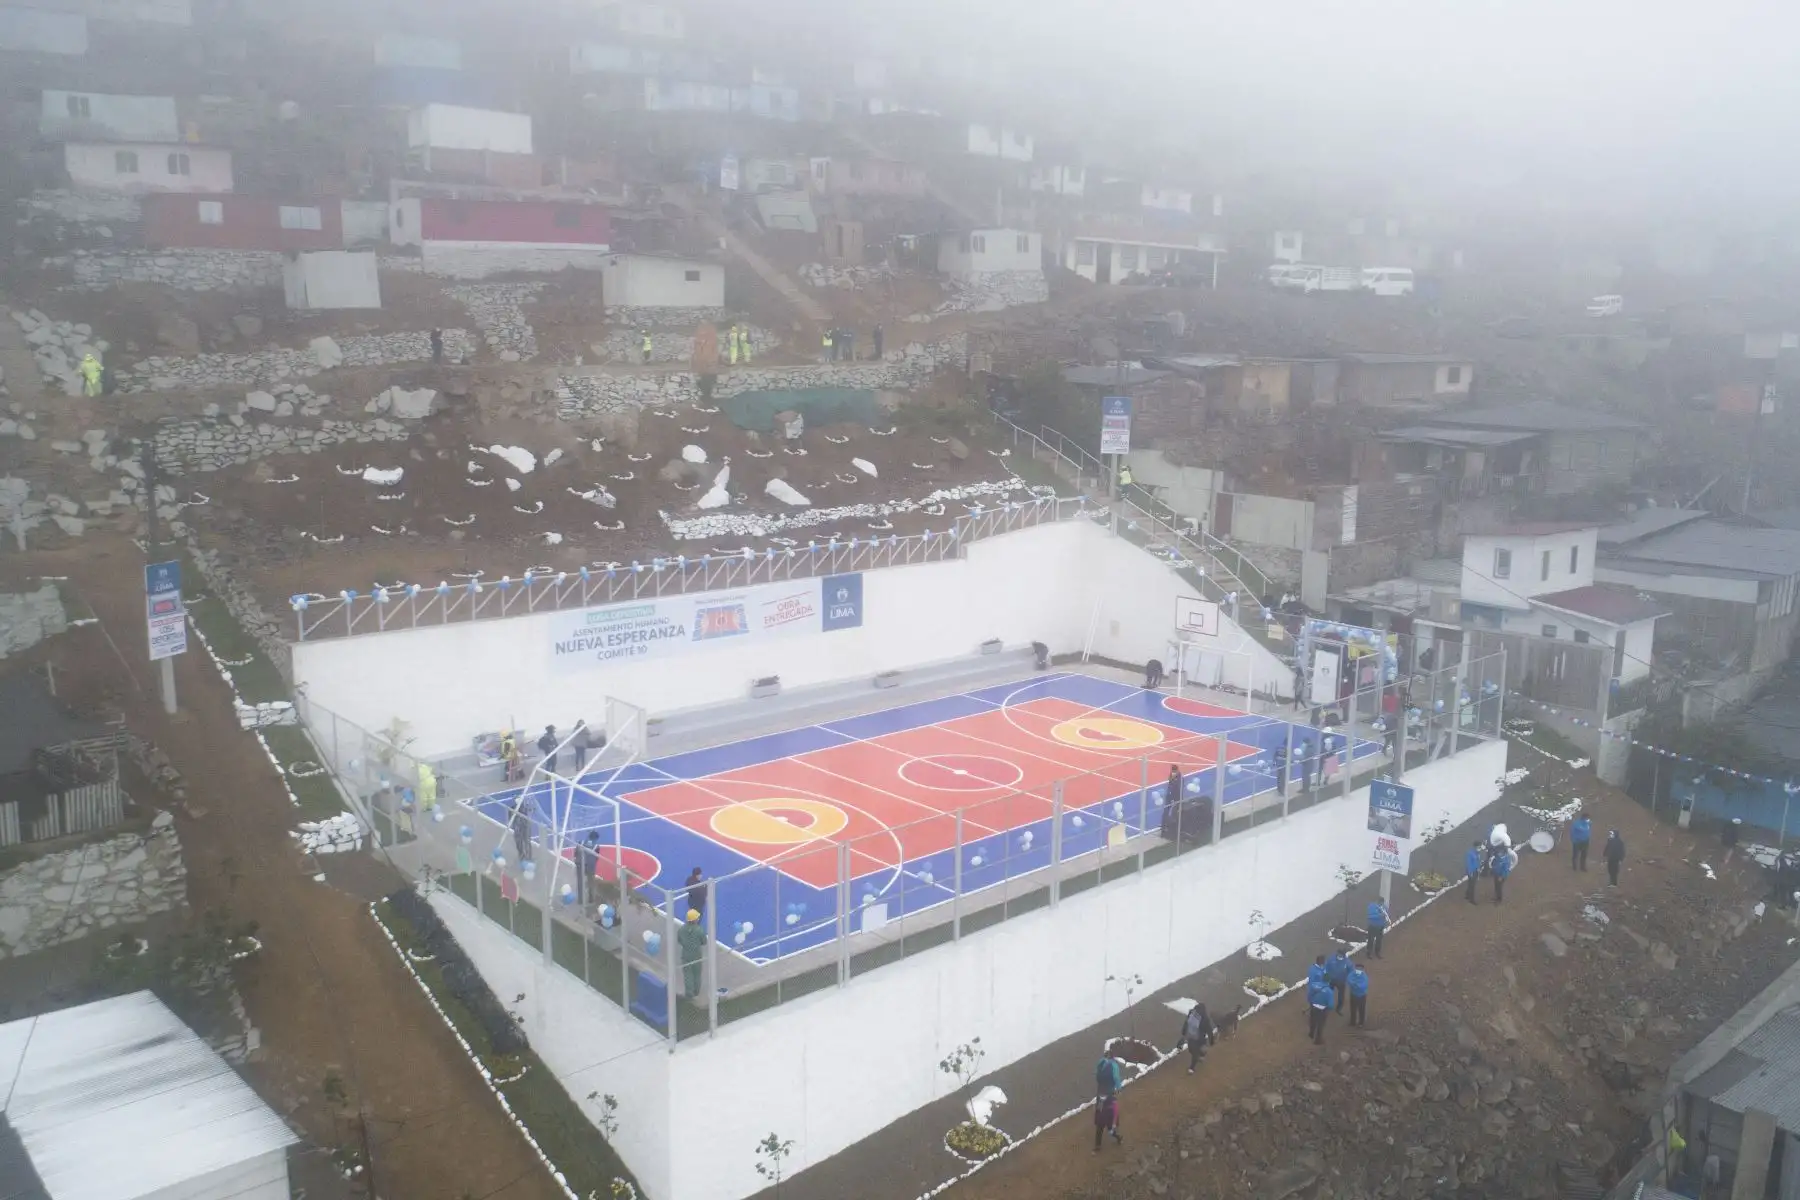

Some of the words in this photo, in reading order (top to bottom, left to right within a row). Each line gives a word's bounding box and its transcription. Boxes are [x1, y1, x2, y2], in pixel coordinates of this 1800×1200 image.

[777, 599, 801, 612] OBRA
[829, 606, 855, 620] LIMA
[764, 605, 813, 624] ENTREGADA
[573, 621, 634, 638] ASENTAMIENTO
[635, 616, 670, 628] HUMANO
[555, 635, 605, 655] NUEVA
[607, 625, 686, 647] ESPERANZA
[597, 645, 636, 661] COMITÉ
[638, 644, 648, 655] 10
[1380, 799, 1402, 810] LIMA
[1373, 850, 1401, 865] LIMA
